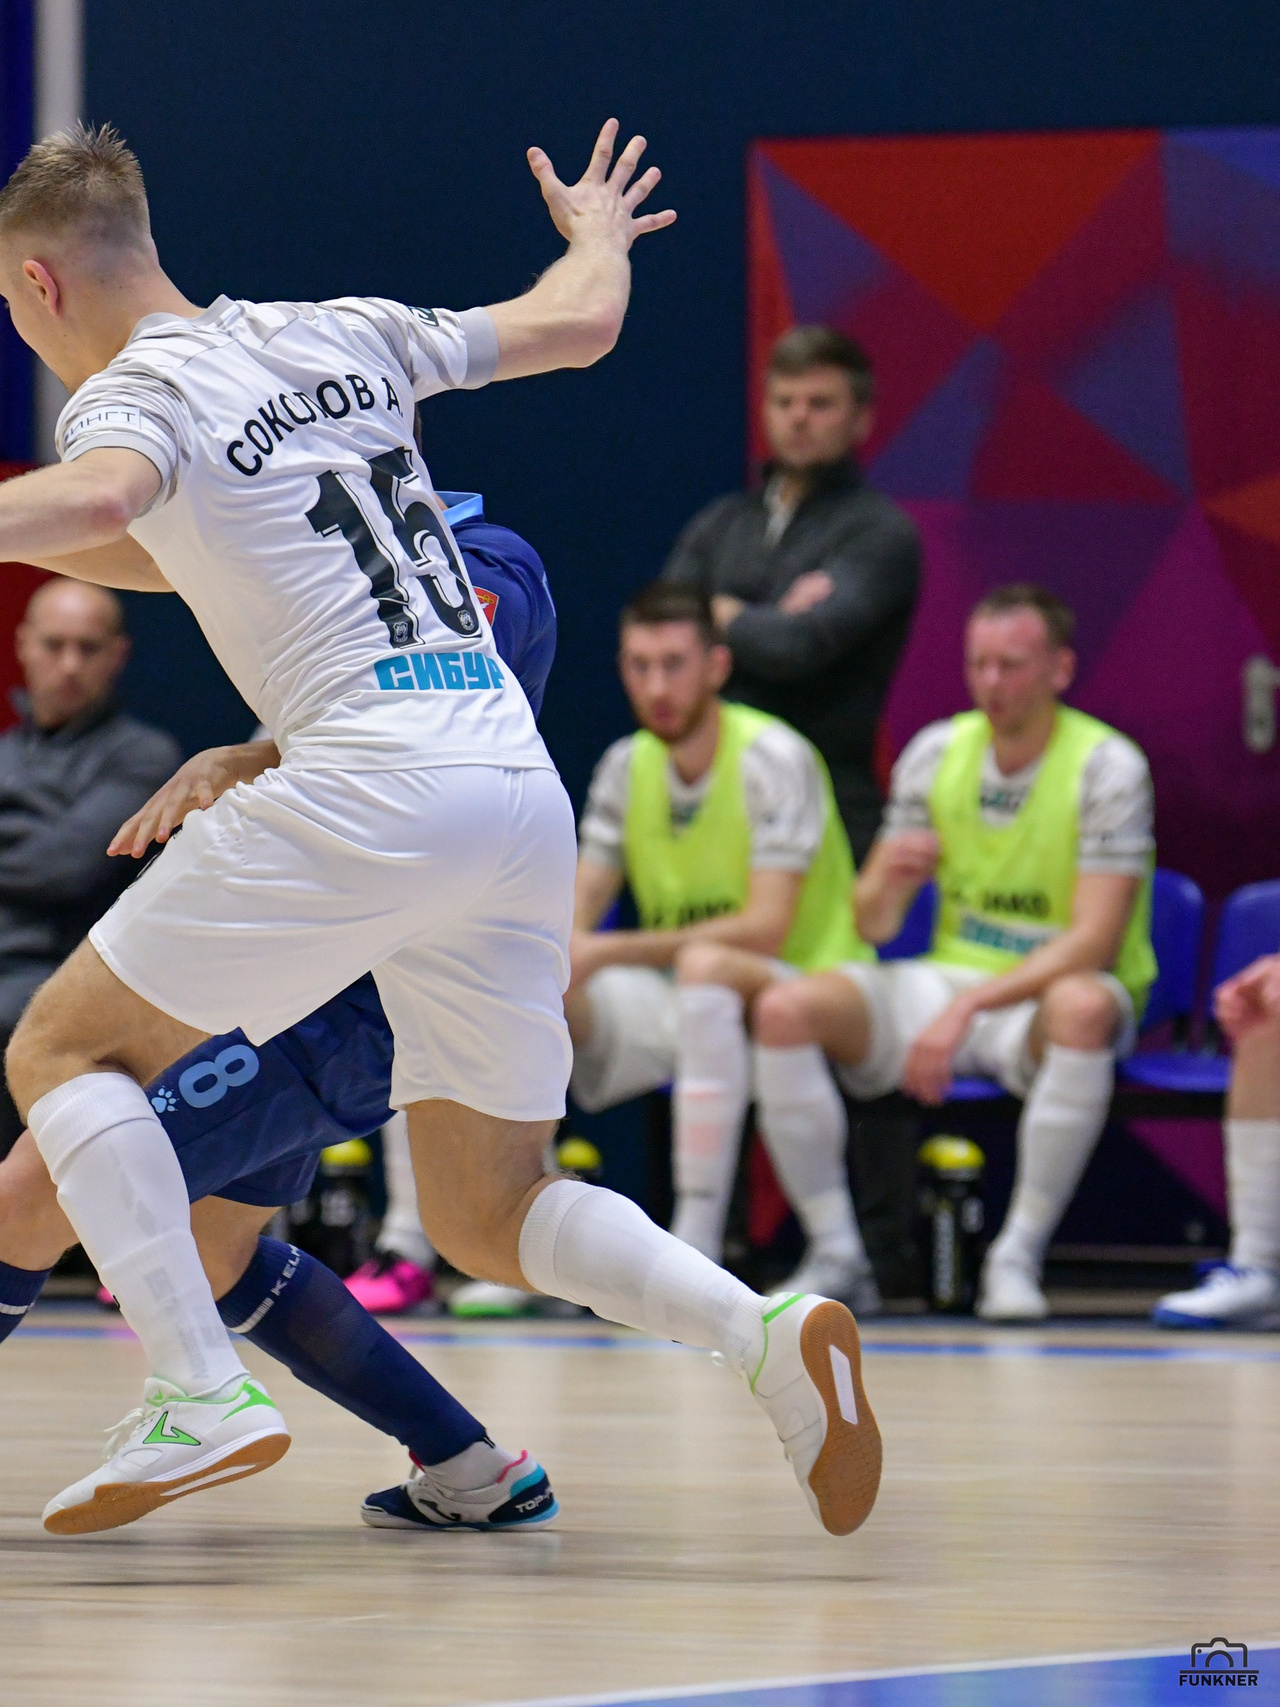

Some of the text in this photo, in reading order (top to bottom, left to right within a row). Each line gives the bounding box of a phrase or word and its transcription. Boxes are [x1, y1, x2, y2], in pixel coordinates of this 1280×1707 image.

[64, 411, 136, 442] ИНГТ
[226, 373, 375, 477] СОКОЛОВ
[304, 446, 482, 650] 15
[178, 1044, 260, 1109] 8
